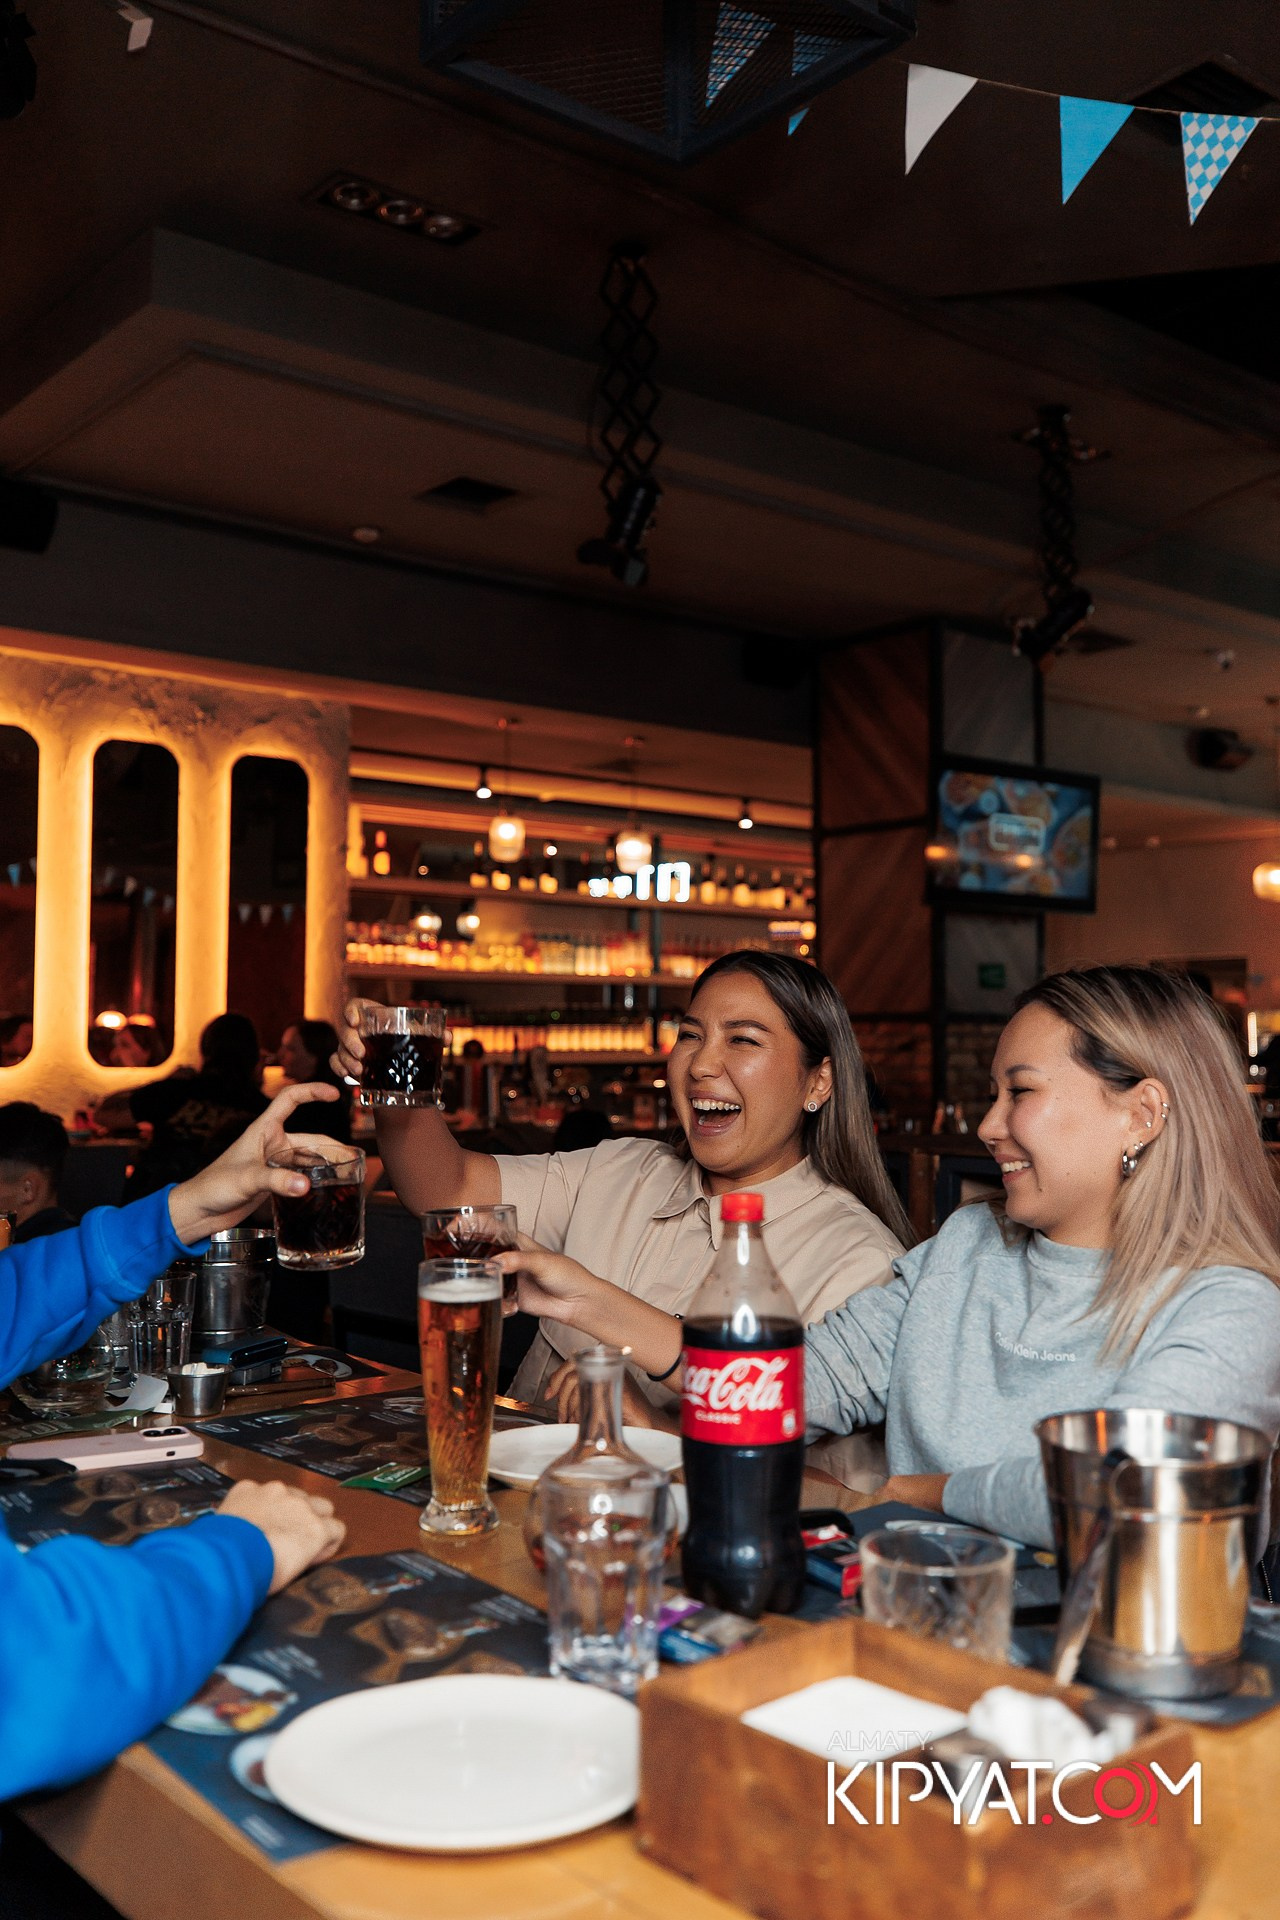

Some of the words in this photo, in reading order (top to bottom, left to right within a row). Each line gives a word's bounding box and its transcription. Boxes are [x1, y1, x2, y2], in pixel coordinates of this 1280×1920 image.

[1013, 1343, 1039, 1360] Klein
[1040, 1350, 1076, 1362] Jeans
[682, 1355, 790, 1411] ca-Cola
